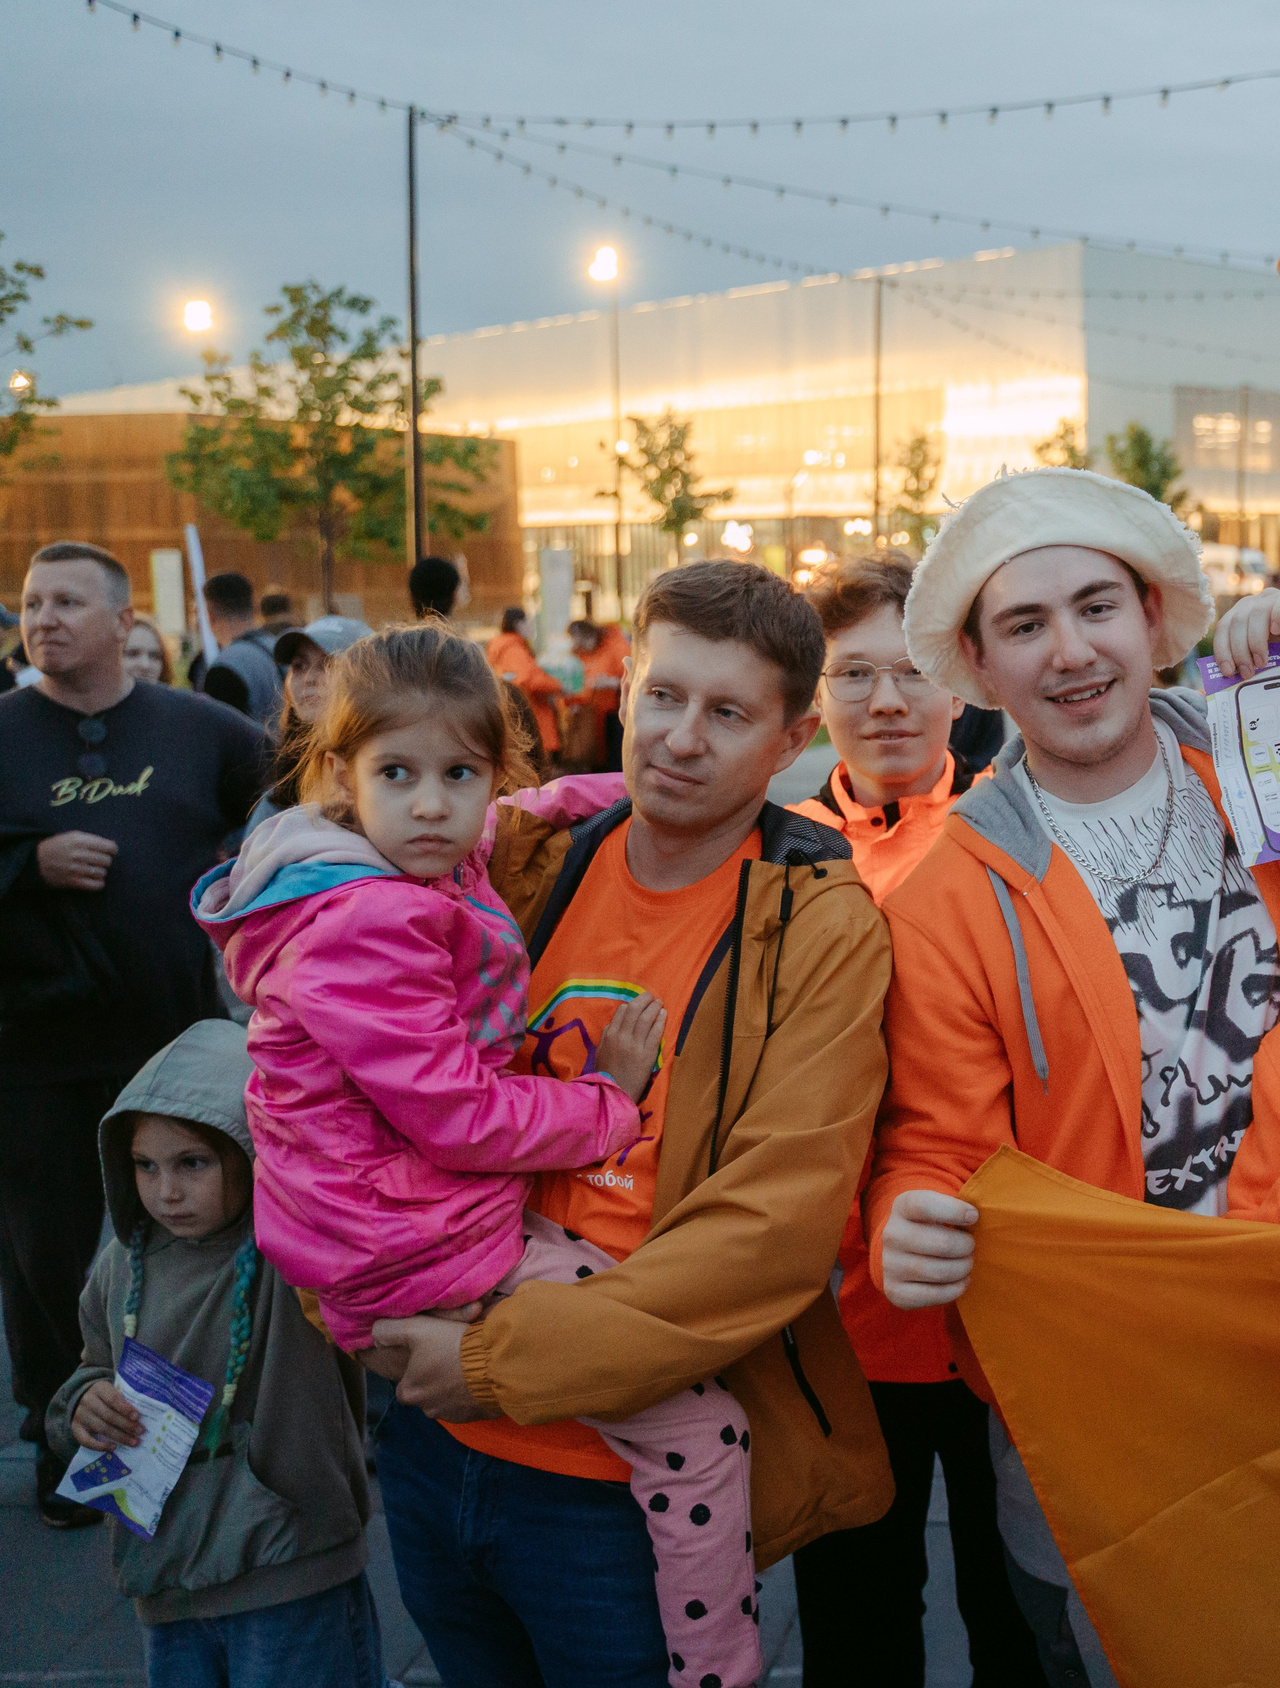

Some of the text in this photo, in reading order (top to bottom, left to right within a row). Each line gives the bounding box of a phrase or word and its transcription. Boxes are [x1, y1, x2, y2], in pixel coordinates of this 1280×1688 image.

[1223, 786, 1234, 815] владельца
[1236, 832, 1245, 856] Фамилия
[588, 1170, 634, 1191] тобой
